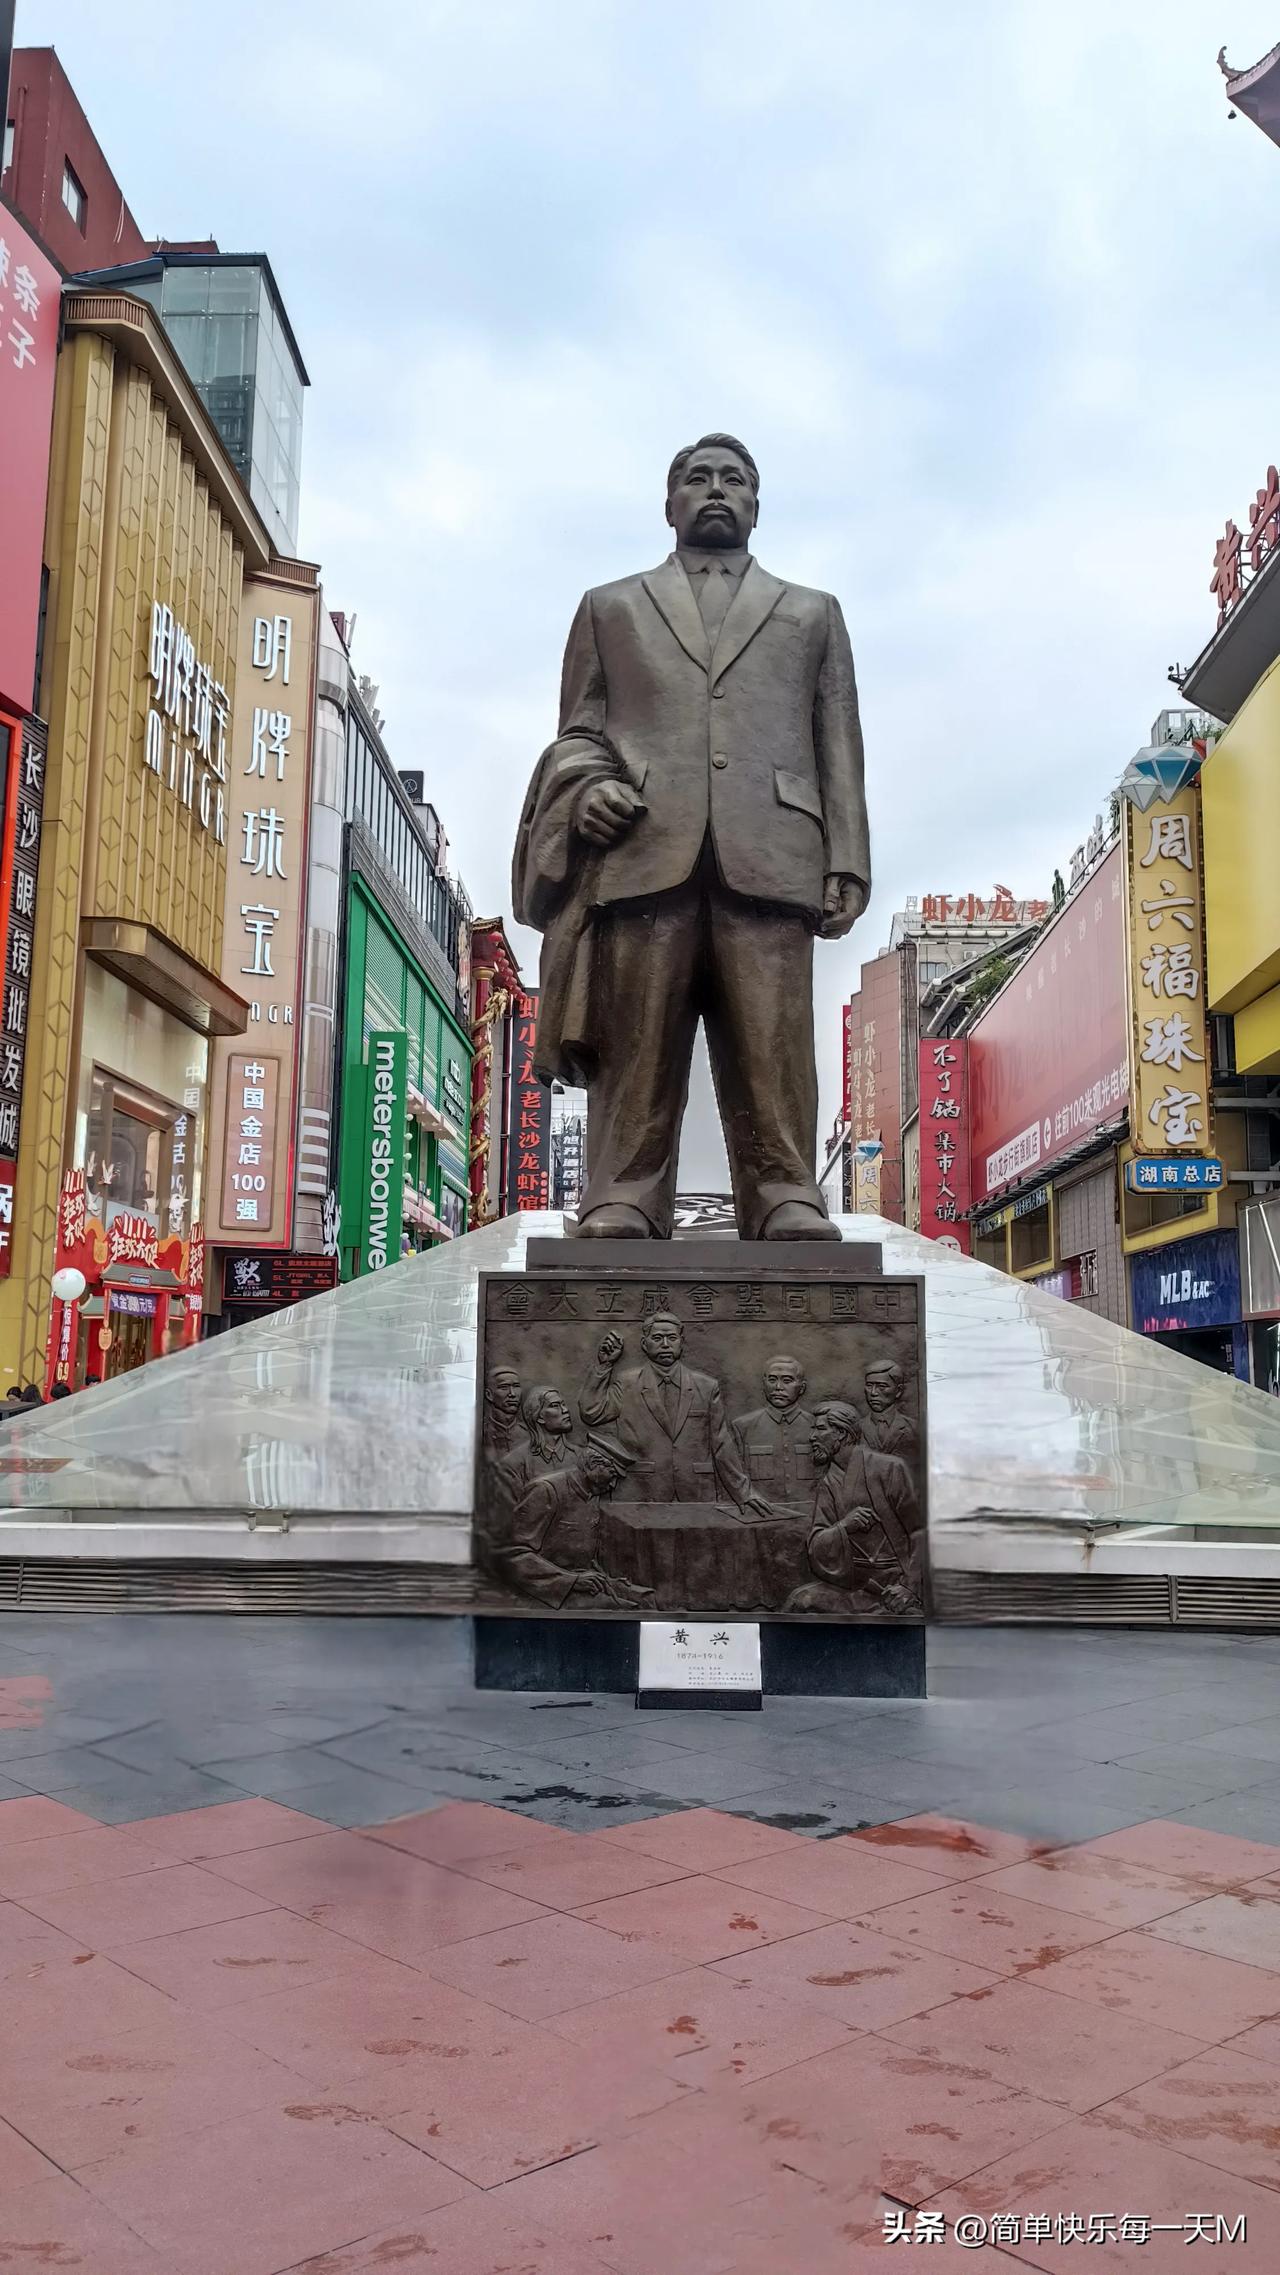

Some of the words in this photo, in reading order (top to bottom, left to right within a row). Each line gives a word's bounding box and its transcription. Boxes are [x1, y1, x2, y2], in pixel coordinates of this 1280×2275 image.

[149, 600, 230, 784] 明牌珠宝
[240, 615, 291, 977] 明牌珠宝
[0, 742, 42, 1149] 长沙眼镜批发城
[1140, 814, 1206, 1146] 周六福珠宝
[231, 1061, 266, 1221] 中国金店100强
[368, 1041, 397, 1270] metersbonwe
[930, 1044, 961, 1119] 不了锅
[934, 1130, 958, 1223] 集市火锅
[1140, 1165, 1223, 1184] 湖南总店
[670, 1628, 730, 1646] 黄兴
